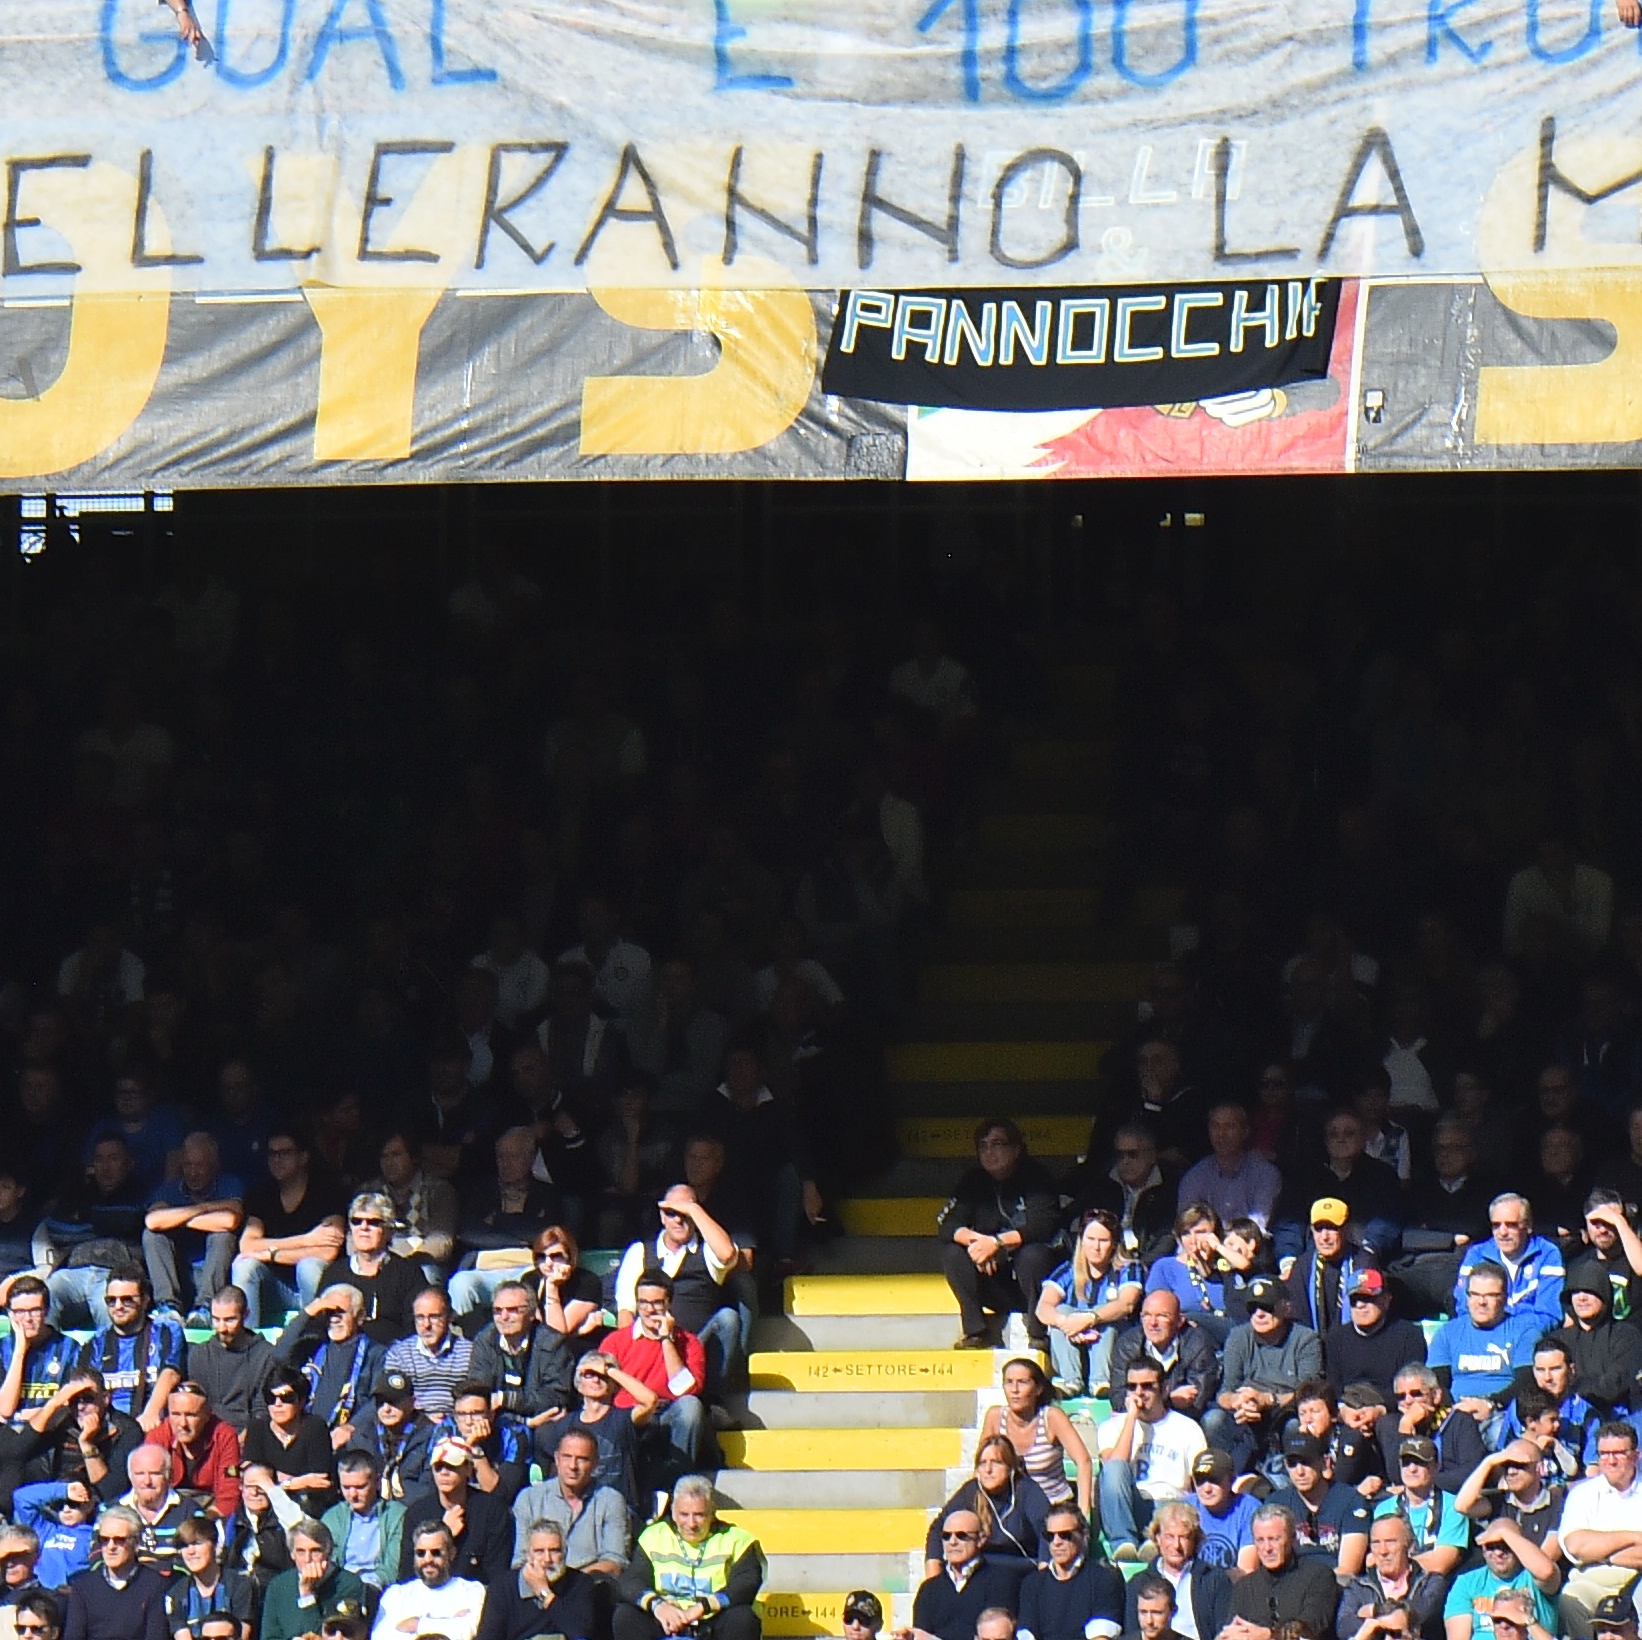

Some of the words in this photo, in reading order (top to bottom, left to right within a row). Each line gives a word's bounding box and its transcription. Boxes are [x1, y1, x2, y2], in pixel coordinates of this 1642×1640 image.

[1213, 125, 1426, 264] LA
[808, 1364, 829, 1378] 142
[845, 1363, 918, 1377] SETTORE
[933, 1364, 954, 1376] 144
[1458, 1354, 1502, 1372] PUMA
[815, 1606, 836, 1619] 144
